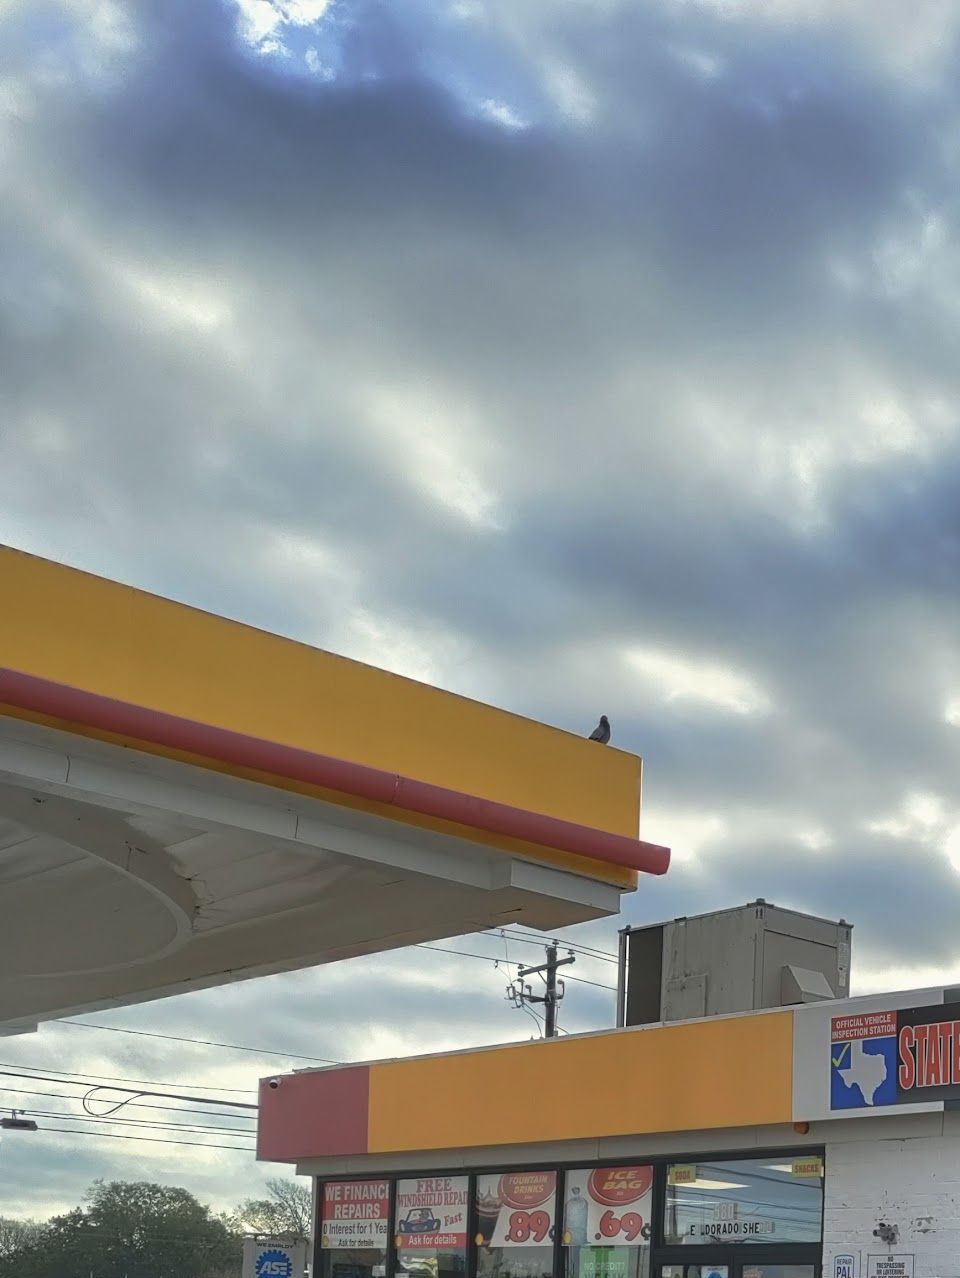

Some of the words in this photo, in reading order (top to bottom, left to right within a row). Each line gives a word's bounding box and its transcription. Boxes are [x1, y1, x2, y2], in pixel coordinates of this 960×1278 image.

[836, 1017, 864, 1030] OFFICIAL
[864, 1013, 892, 1026] VEHICLE
[832, 1026, 868, 1040] INSPECTION
[869, 1023, 897, 1036] STATION
[509, 1175, 548, 1185] FOUNTAIN
[607, 1170, 639, 1181] ICE
[416, 1178, 453, 1193] FREE
[513, 1184, 545, 1194] DRINKS
[602, 1180, 643, 1190] BAG
[325, 1185, 341, 1201] WE
[397, 1193, 443, 1208] WINDSHIELD
[444, 1191, 468, 1206] REPAI
[334, 1203, 381, 1219] REPAIRS
[444, 1212, 463, 1227] Fast
[323, 1223, 328, 1235] 0
[329, 1223, 356, 1235] Interest
[357, 1222, 368, 1235] for
[338, 1239, 349, 1247] Ask
[358, 1239, 375, 1247] details
[408, 1234, 422, 1246] Ask
[423, 1234, 433, 1245] for
[434, 1234, 457, 1245] details
[260, 1261, 288, 1276] ASE
